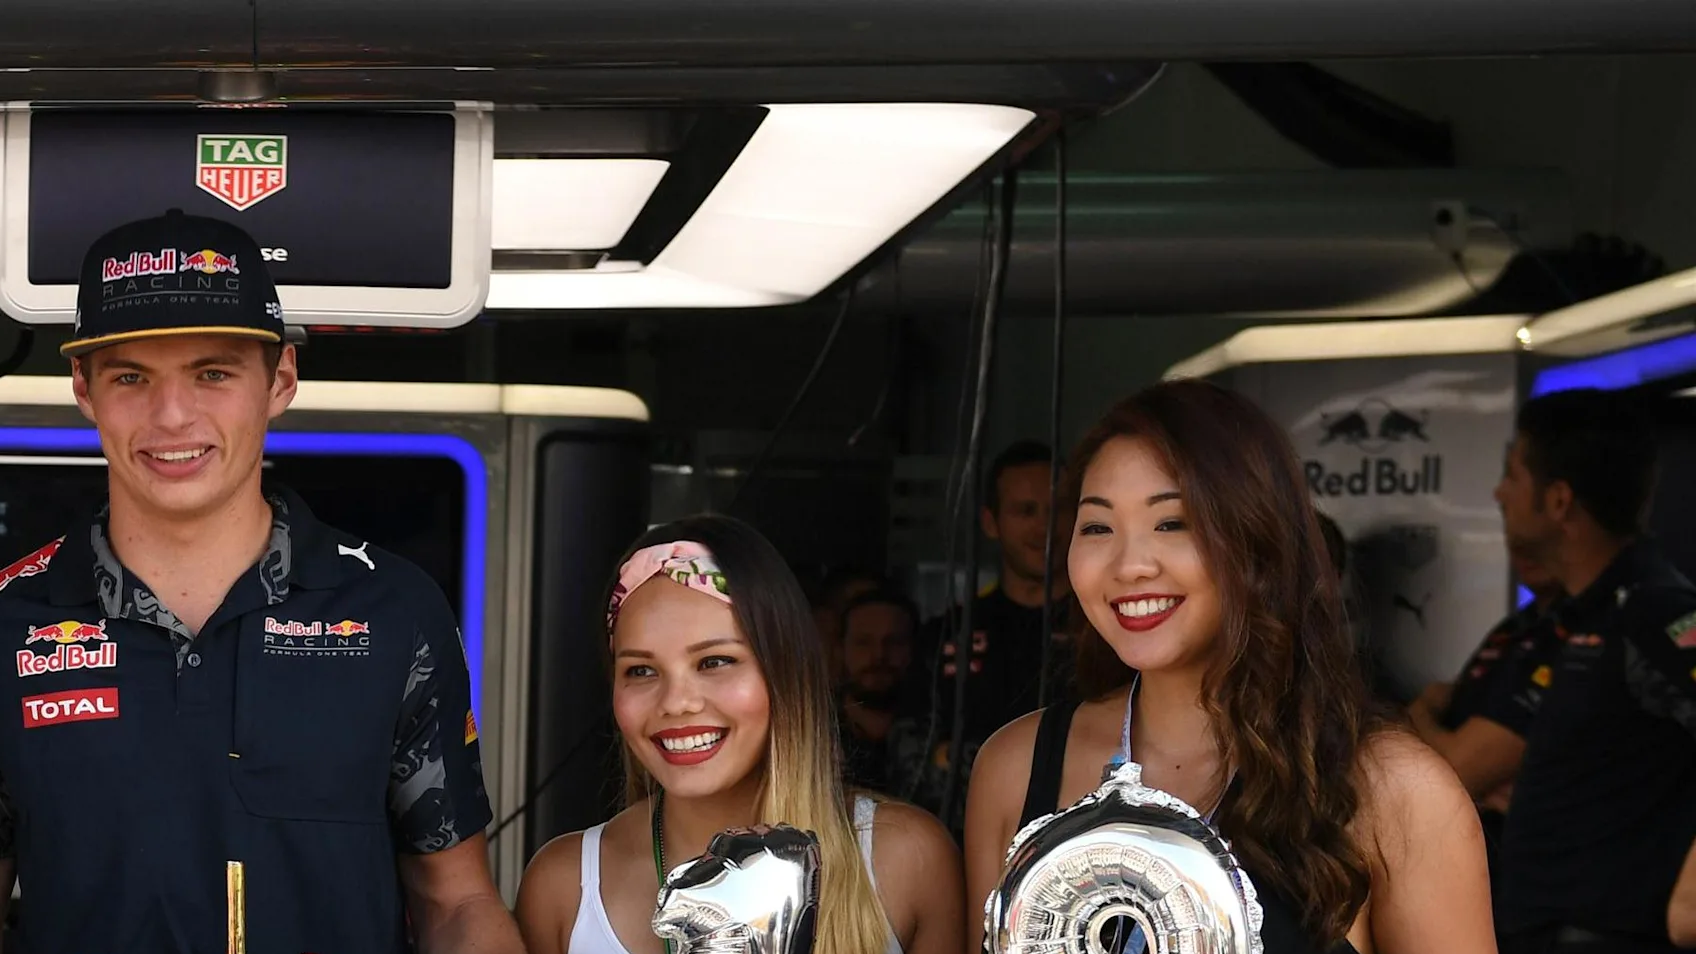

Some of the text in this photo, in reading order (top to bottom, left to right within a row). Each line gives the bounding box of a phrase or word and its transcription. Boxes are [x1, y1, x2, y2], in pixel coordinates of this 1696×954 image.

[205, 140, 278, 163] TAG
[203, 168, 281, 204] HEUER
[103, 248, 176, 281] Red Bull
[103, 276, 240, 298] RACING
[102, 296, 240, 312] FORMULA ONE TEAM
[1304, 453, 1442, 498] Red Bull
[265, 617, 322, 637] Red Bull
[263, 648, 311, 656] FORMULA
[264, 635, 370, 646] RACING
[17, 642, 117, 677] Red Bull
[25, 697, 115, 721] TOTAL
